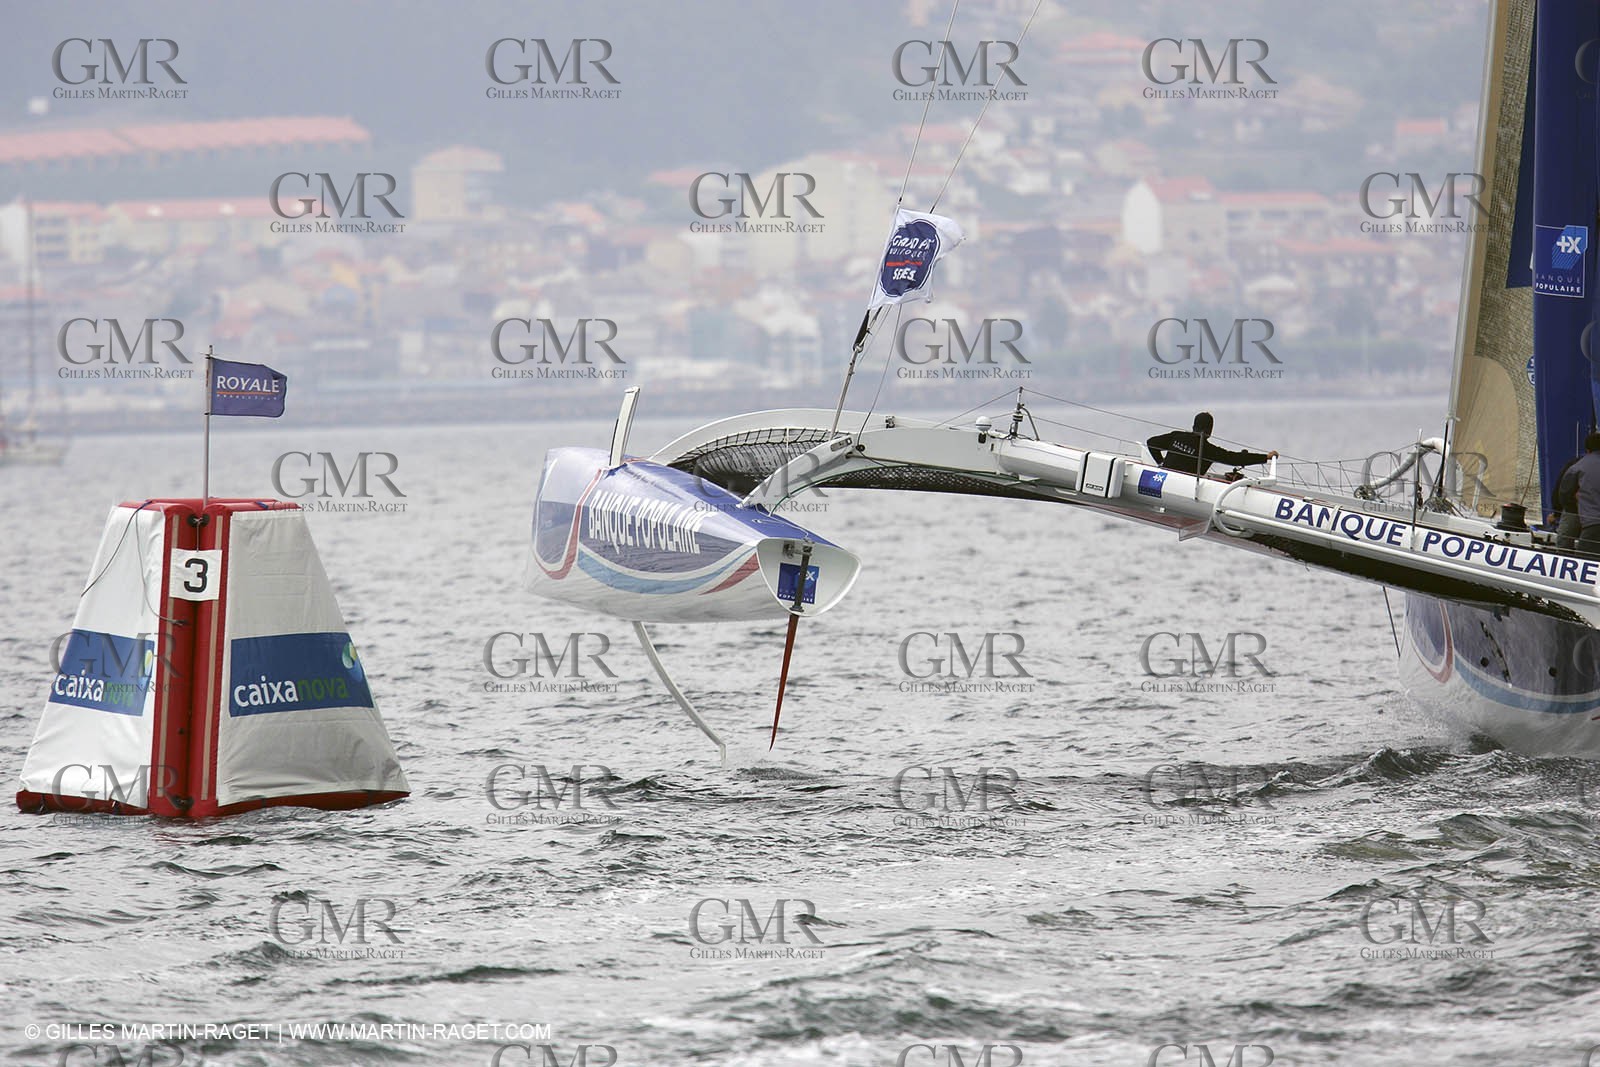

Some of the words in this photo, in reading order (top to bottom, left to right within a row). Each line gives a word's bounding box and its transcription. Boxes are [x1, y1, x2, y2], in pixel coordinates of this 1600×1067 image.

[1535, 282, 1581, 293] POPULAIRE
[217, 376, 279, 392] ROYALE
[1275, 498, 1407, 547] BANQUE
[1422, 531, 1599, 584] POPULAIRE
[184, 558, 208, 593] 3
[234, 675, 349, 707] caixanova
